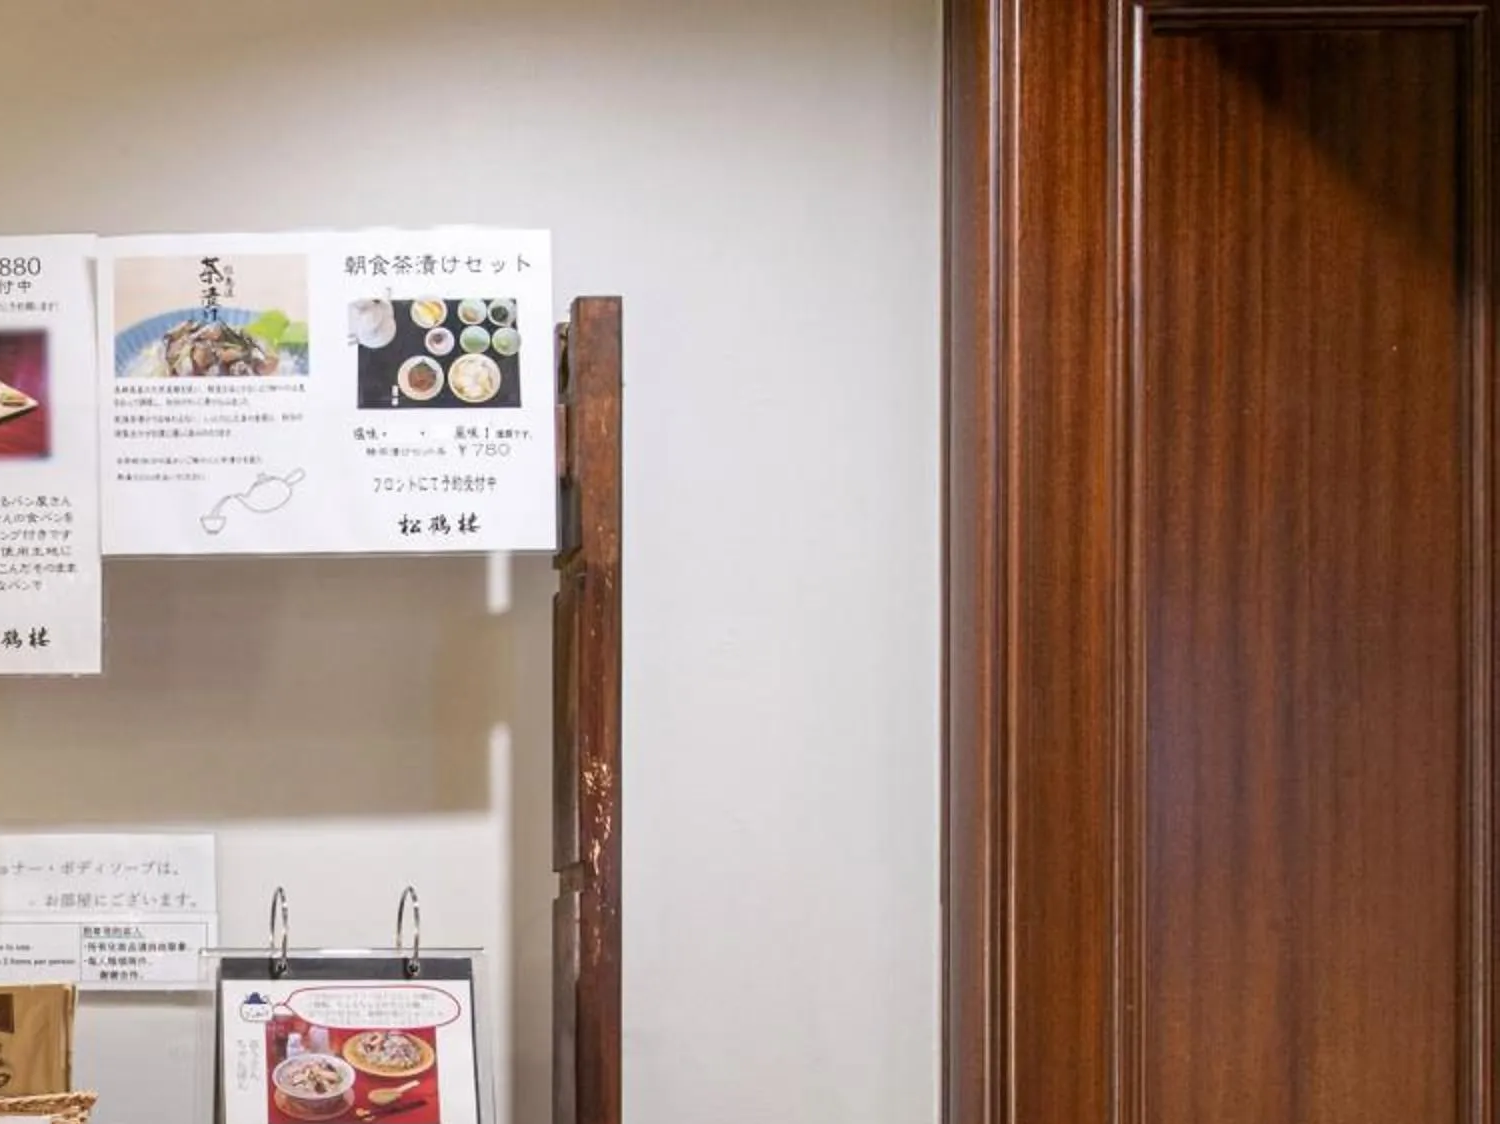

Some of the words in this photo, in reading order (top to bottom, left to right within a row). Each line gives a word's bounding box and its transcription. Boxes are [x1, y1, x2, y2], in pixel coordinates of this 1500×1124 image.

[344, 254, 531, 276] 朝食茶漬けセット
[374, 475, 497, 492] フロントにて予約受付中
